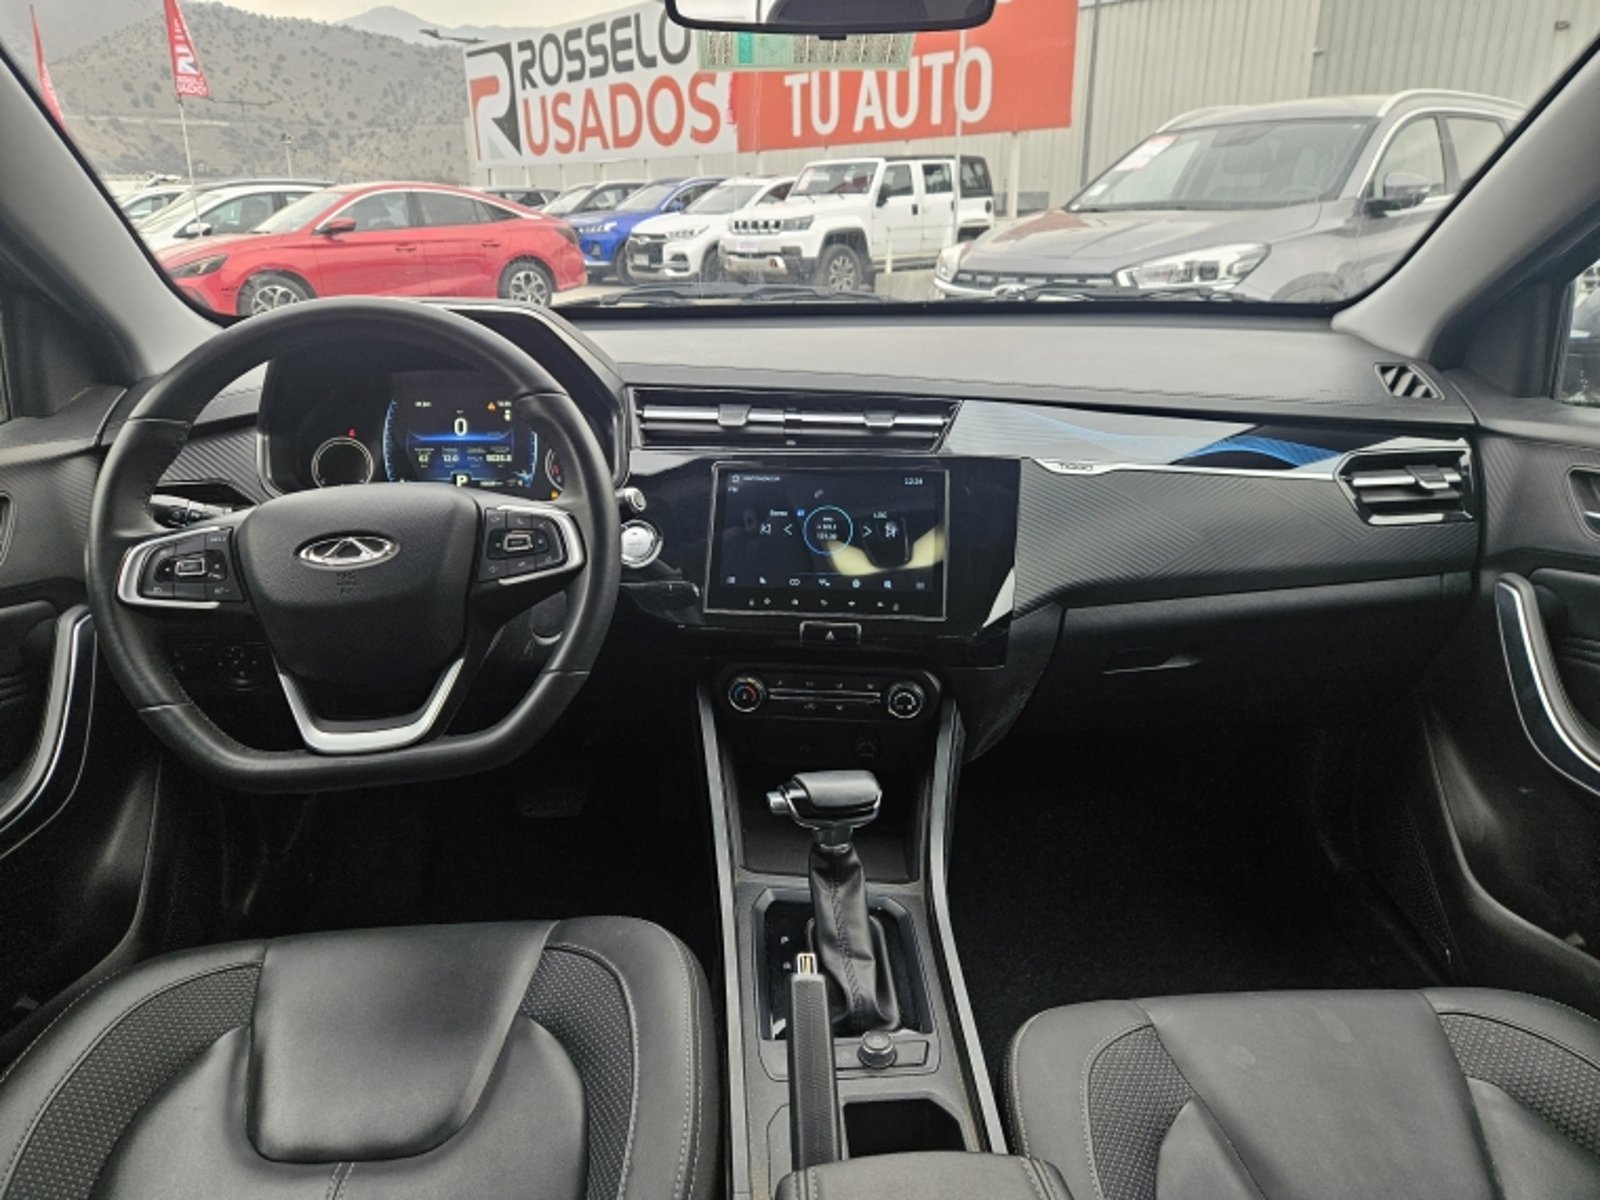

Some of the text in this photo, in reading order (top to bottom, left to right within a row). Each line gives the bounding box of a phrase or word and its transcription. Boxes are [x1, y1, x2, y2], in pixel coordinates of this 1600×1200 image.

[522, 71, 721, 156] USADOS
[784, 47, 993, 138] TU AUTO
[454, 417, 468, 436] 0
[456, 475, 468, 487] P
